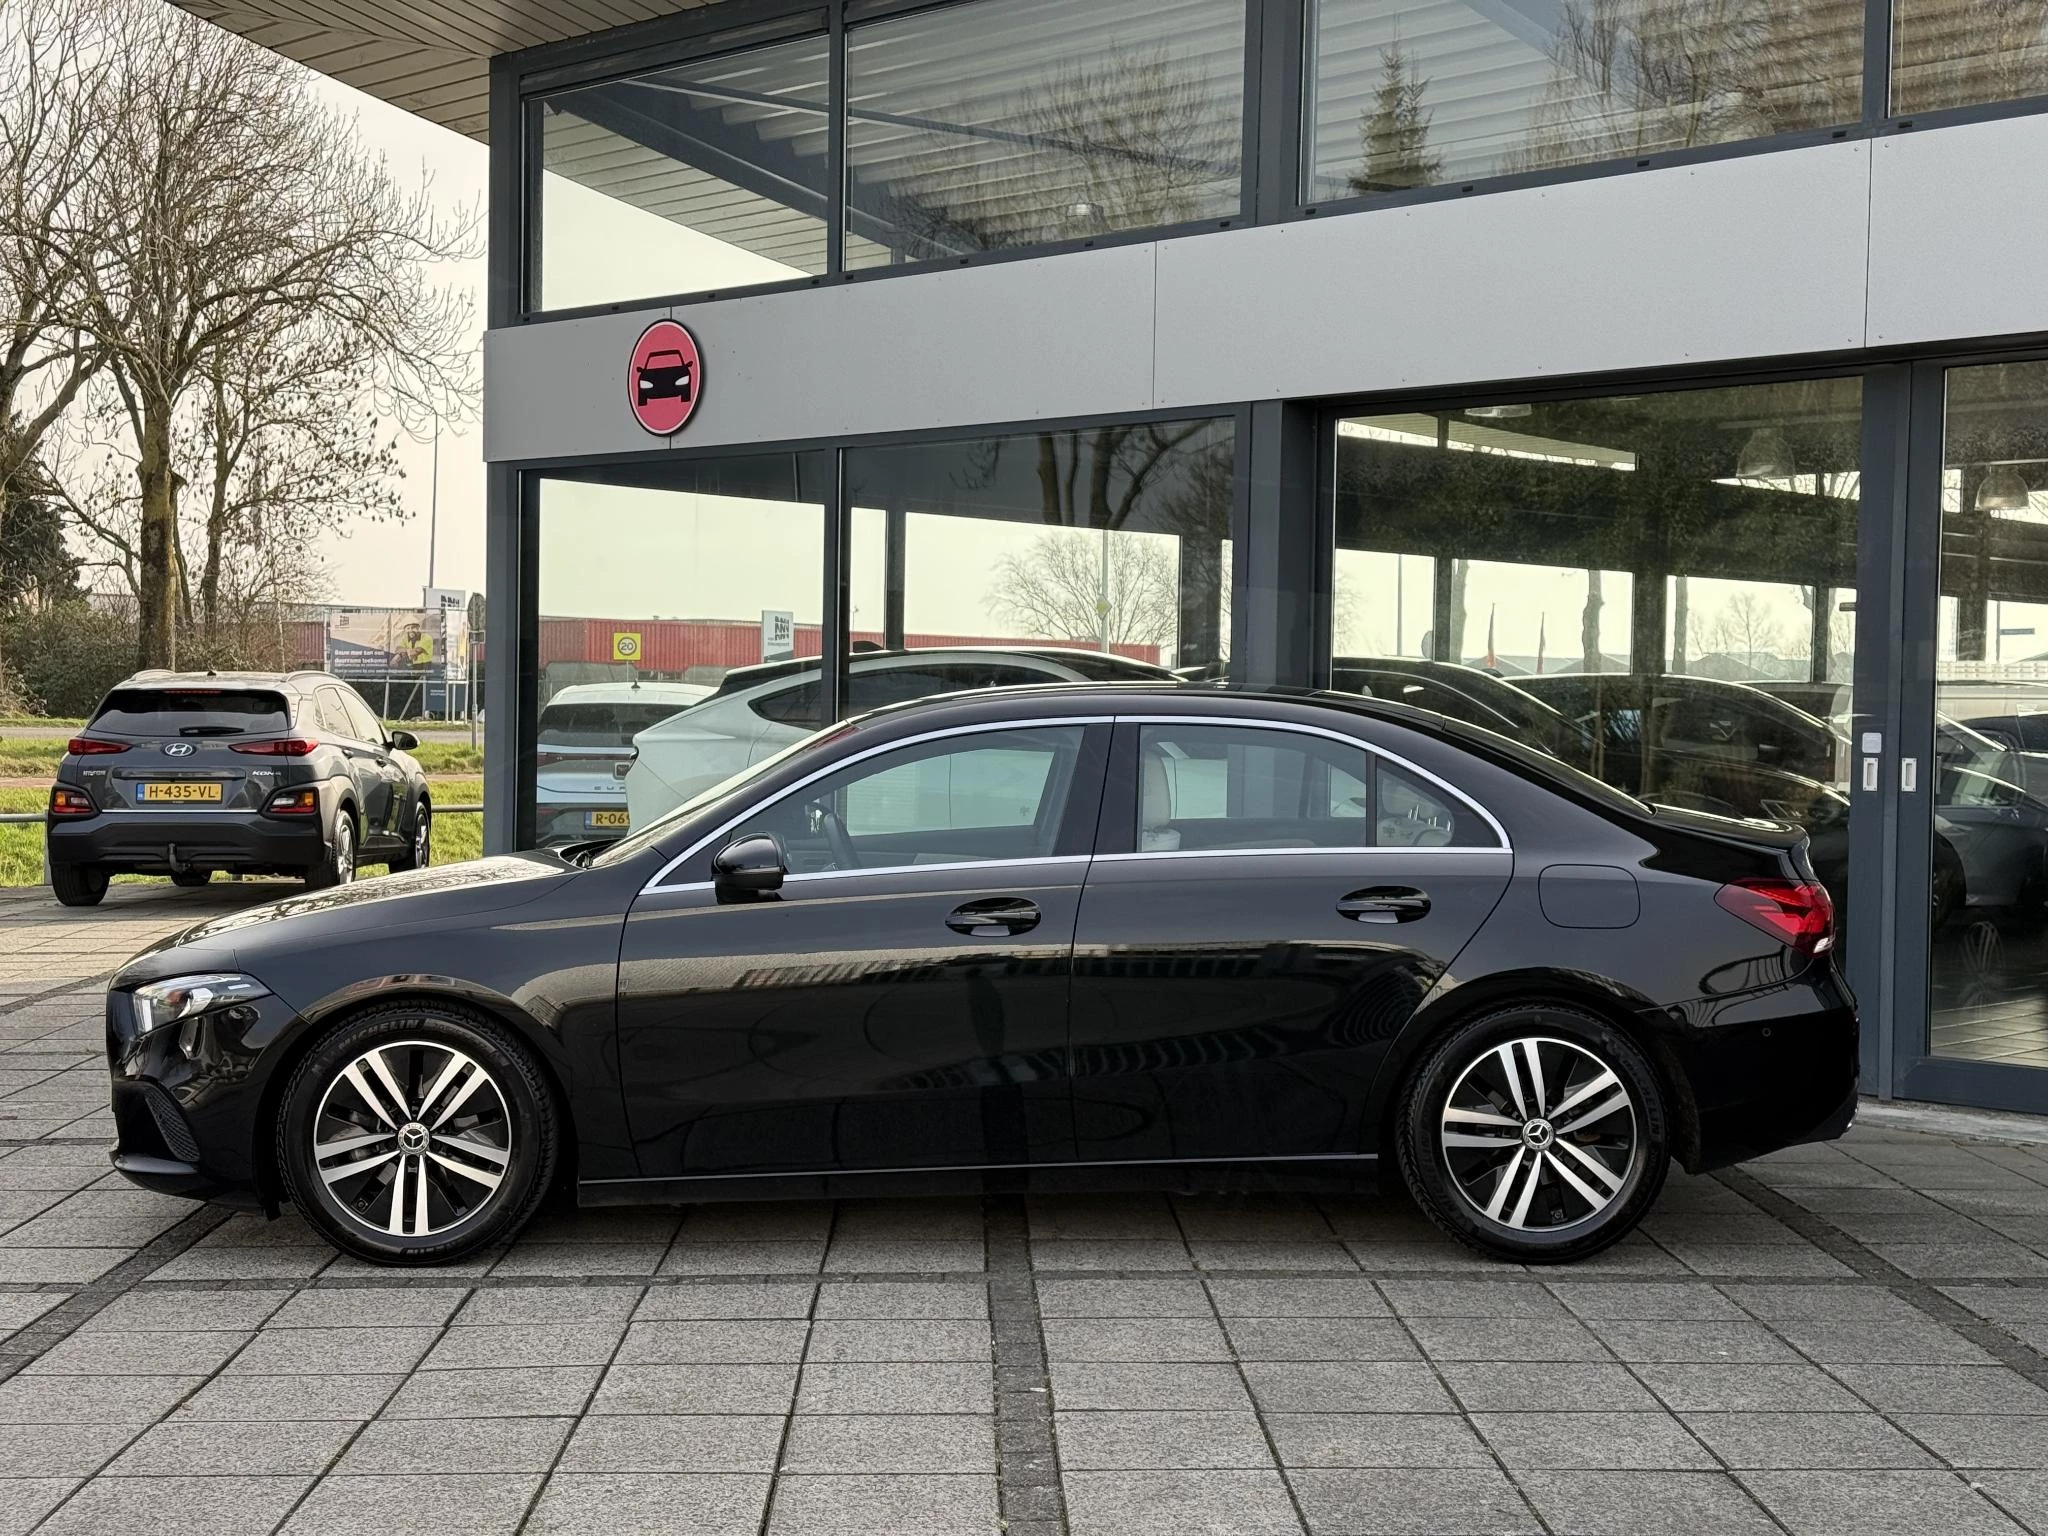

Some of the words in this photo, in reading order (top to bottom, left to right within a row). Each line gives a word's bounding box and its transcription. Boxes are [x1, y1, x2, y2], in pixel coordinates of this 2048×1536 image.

[620, 641, 635, 652] 20
[149, 785, 217, 798] H-435-VL
[595, 813, 630, 825] R-06
[337, 1018, 419, 1050] MICHELIN
